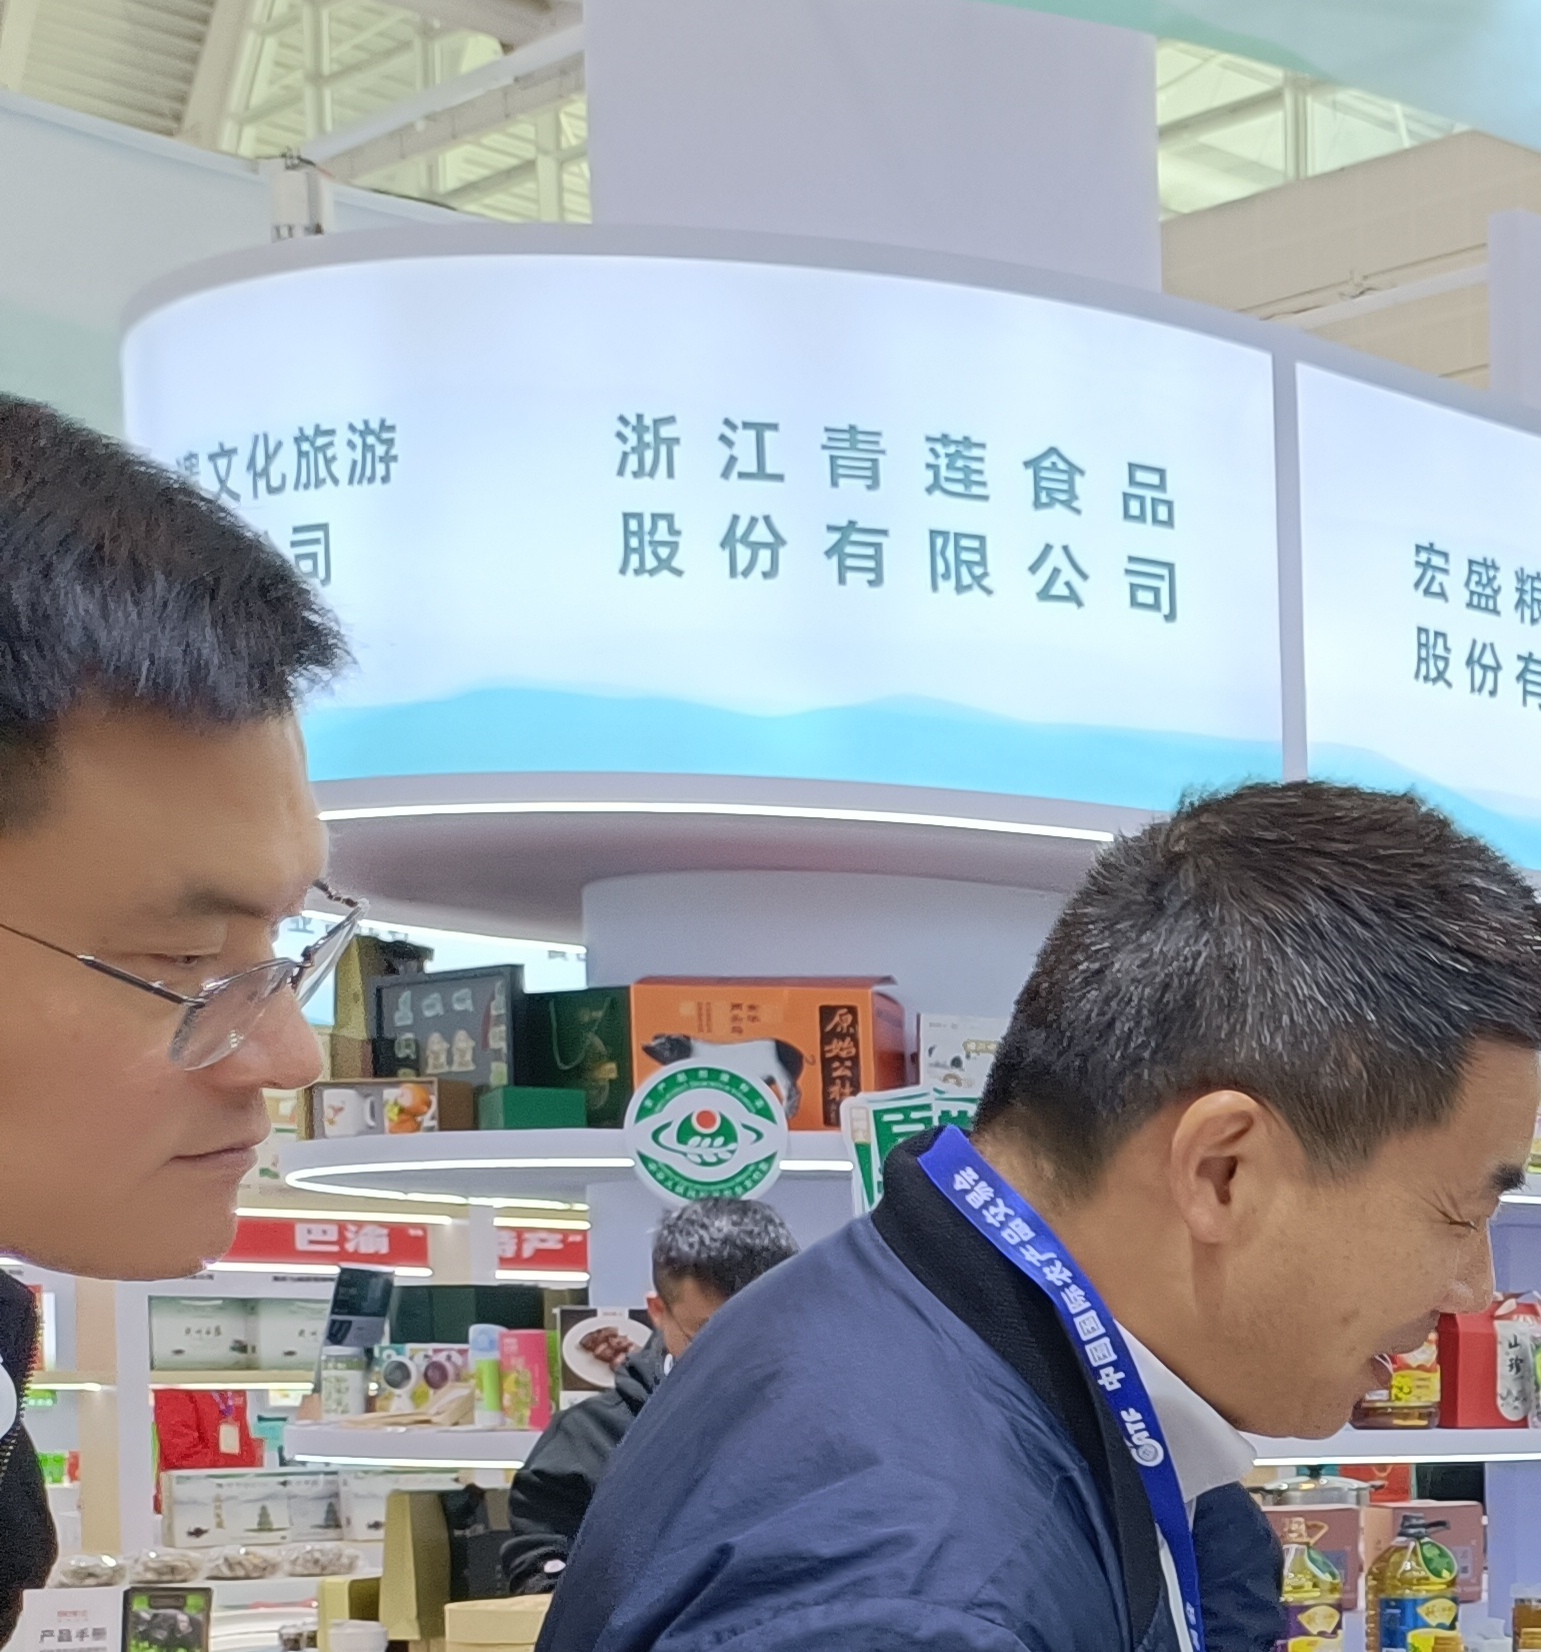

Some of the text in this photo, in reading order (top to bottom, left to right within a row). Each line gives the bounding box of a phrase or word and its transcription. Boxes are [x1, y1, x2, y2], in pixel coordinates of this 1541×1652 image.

[614, 413, 1175, 530] 浙江青莲食品
[618, 511, 1178, 623] 股份有限公司
[953, 1166, 1126, 1392] 中国国际农产品交易会
